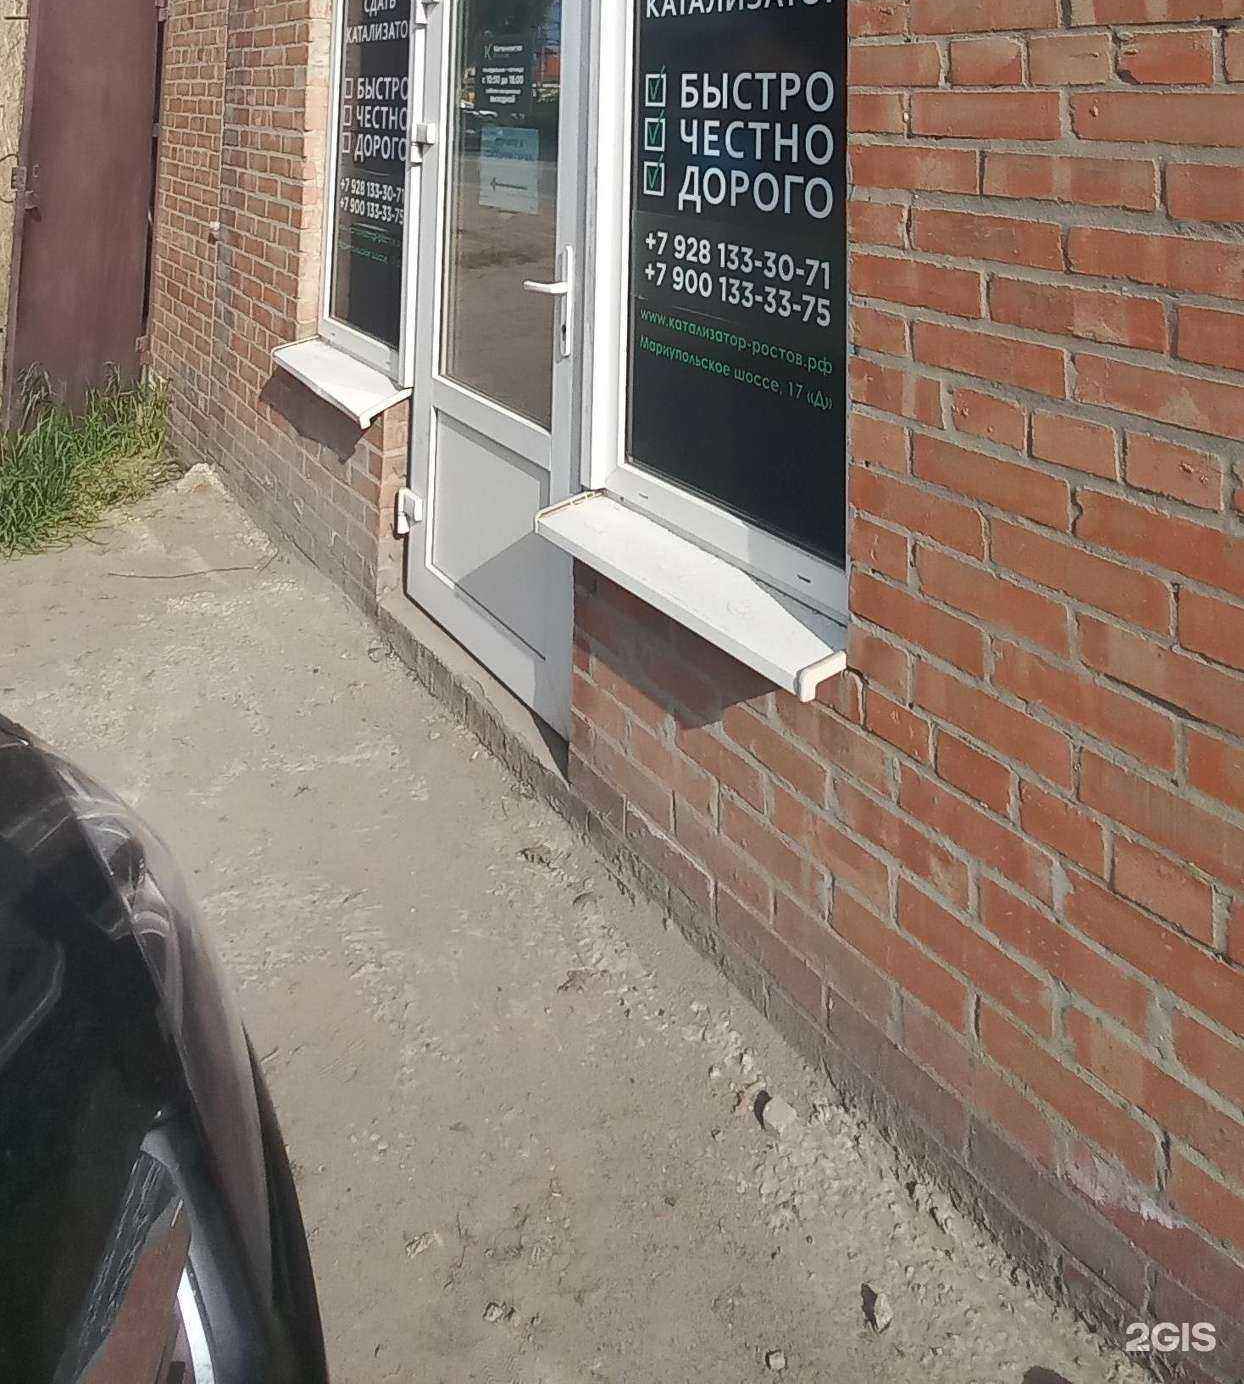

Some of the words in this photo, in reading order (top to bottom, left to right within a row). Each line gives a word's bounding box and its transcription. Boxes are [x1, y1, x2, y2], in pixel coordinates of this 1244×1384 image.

[346, 19, 408, 44] КАТАЛИЗАТО
[357, 76, 408, 100] БЫСТРО
[680, 71, 834, 112] БЫСТРО
[356, 104, 408, 131] ЧЕСТНО
[354, 132, 407, 163] ДОРОГО
[680, 118, 834, 165] ЧЕСТНО
[350, 198, 365, 216] 900
[351, 179, 365, 196] 928
[678, 165, 834, 219] ДОРОГО
[645, 231, 668, 256] +7
[673, 234, 711, 265] 928
[718, 243, 830, 289] 133-30-71
[645, 262, 667, 286] +7
[672, 266, 713, 297] 900
[719, 277, 831, 327] 133-33-75
[640, 308, 833, 377] www.катализатор-ростов.рф
[639, 335, 731, 376] Мариупольское
[734, 368, 783, 395] шоссе,
[788, 381, 804, 400] 17
[807, 391, 833, 410] «Д»
